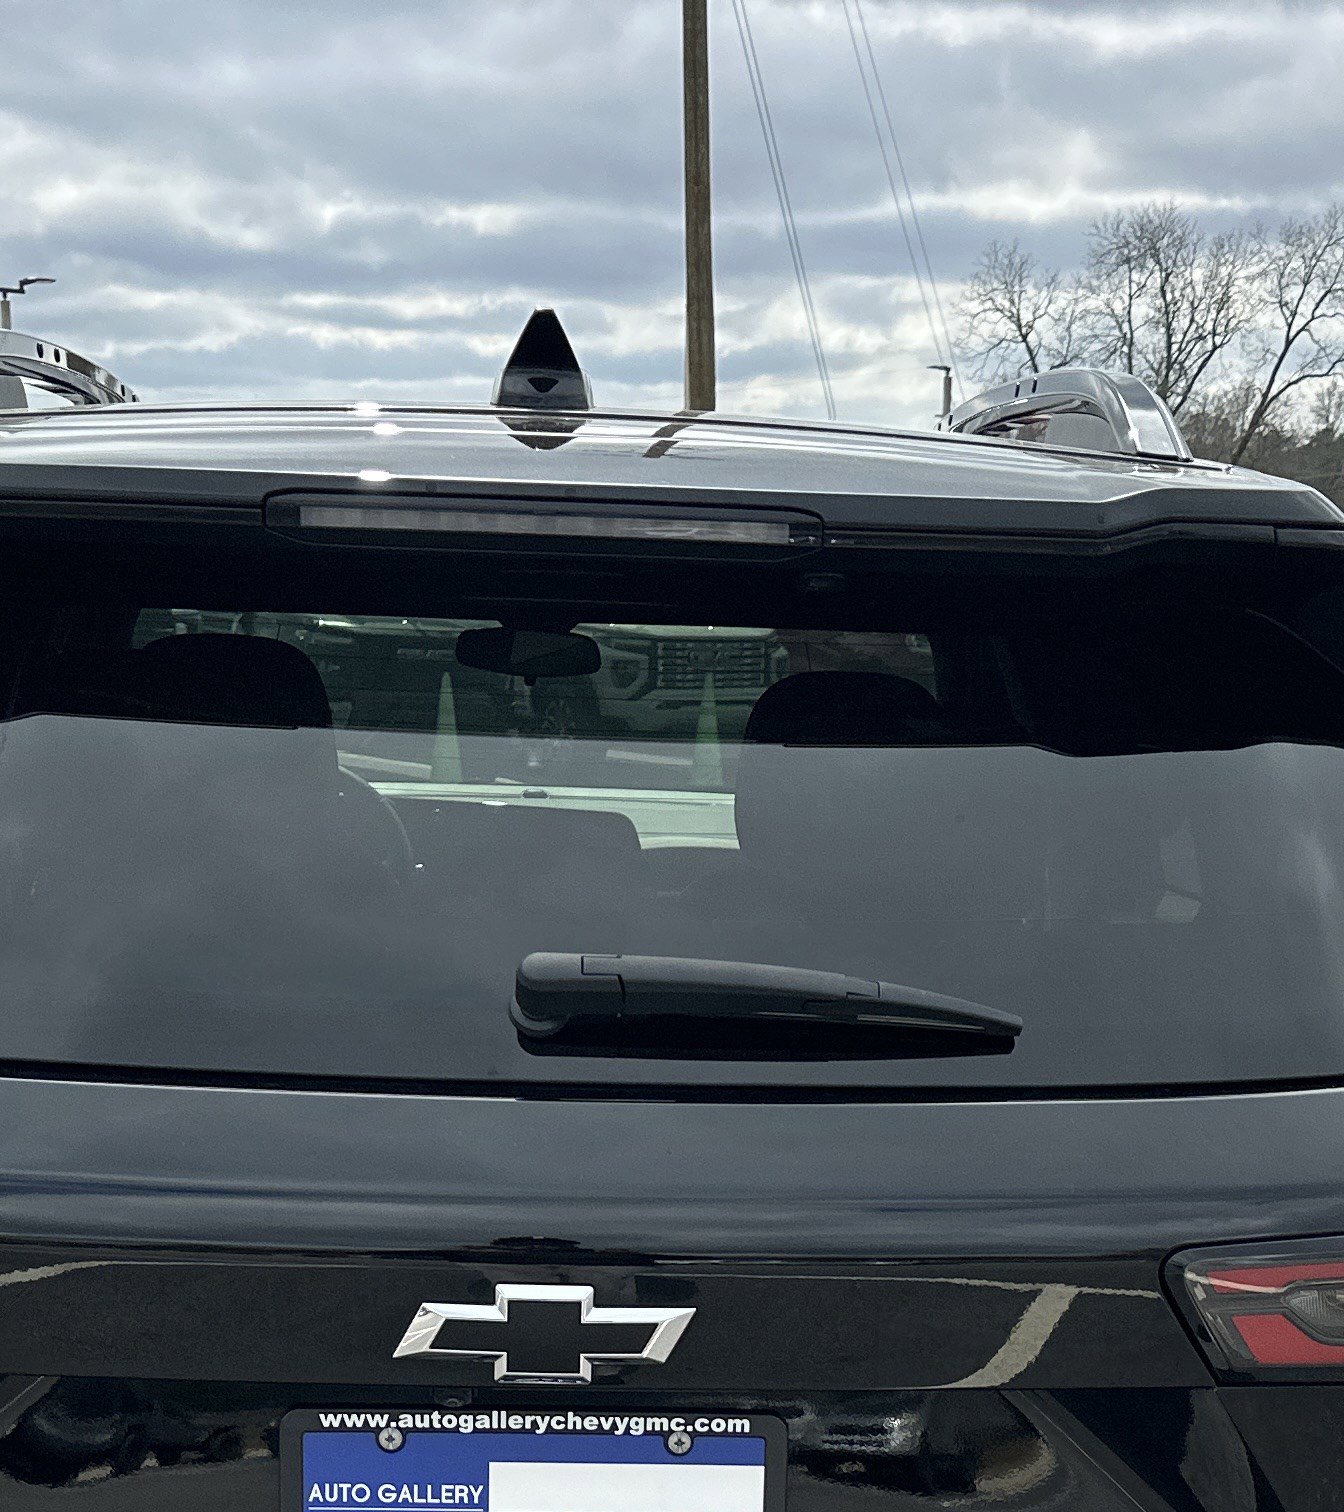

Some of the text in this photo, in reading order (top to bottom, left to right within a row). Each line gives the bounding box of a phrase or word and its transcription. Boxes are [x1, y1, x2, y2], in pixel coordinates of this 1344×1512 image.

[319, 1410, 751, 1436] www.autogallerychevygmc.com
[308, 1483, 484, 1504] AUTO GALLERY
